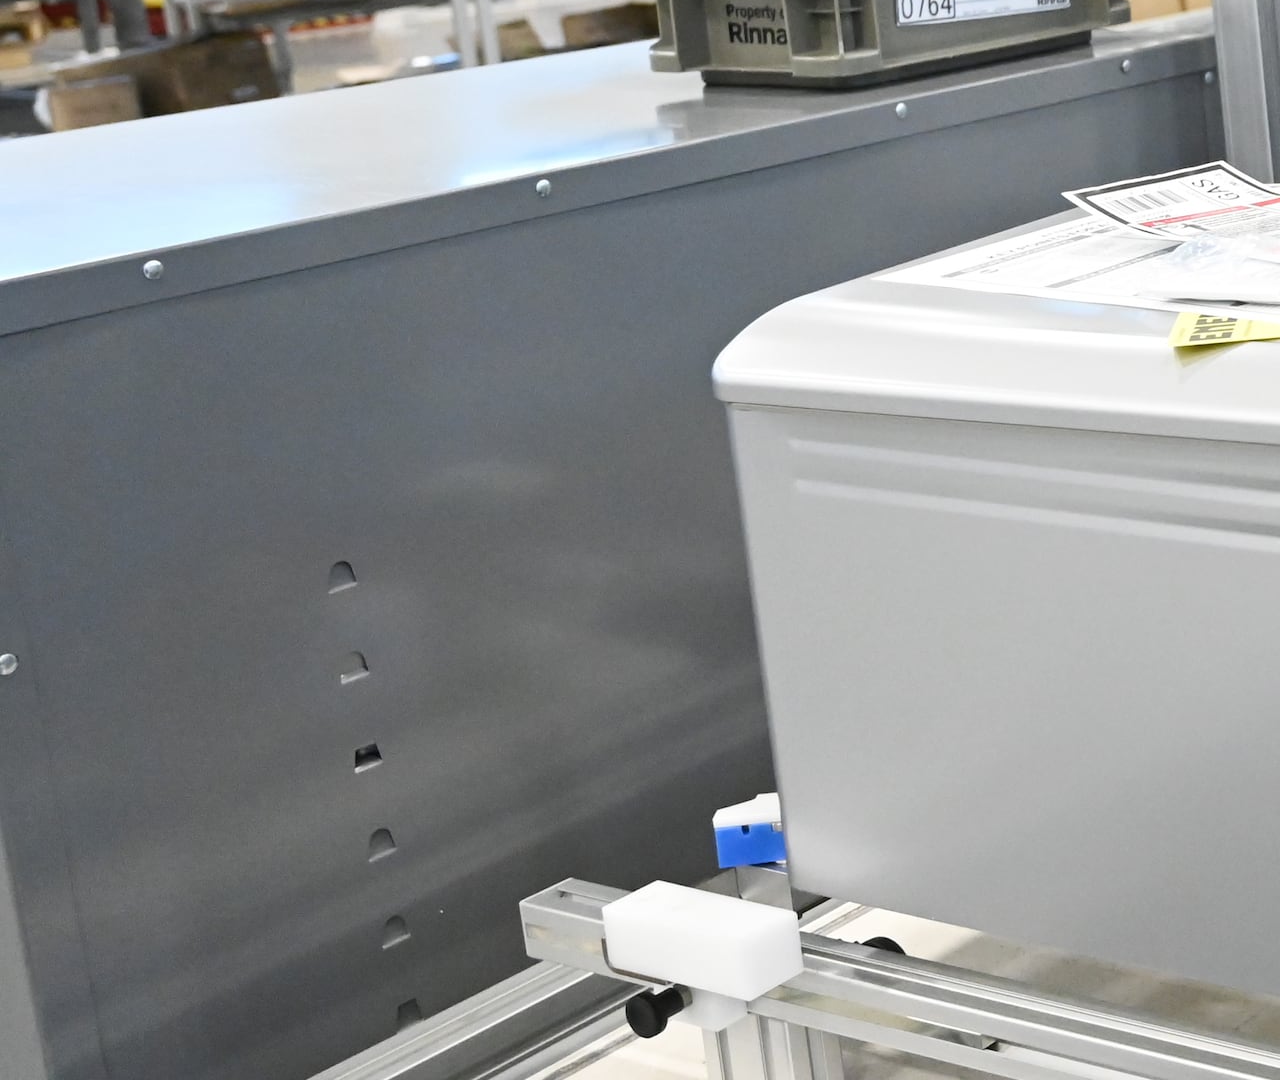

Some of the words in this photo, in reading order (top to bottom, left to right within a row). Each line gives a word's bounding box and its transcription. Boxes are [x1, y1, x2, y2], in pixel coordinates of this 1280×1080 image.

[725, 3, 776, 22] Property
[727, 21, 788, 45] Rinna
[1191, 178, 1241, 202] GAS
[1188, 314, 1238, 342] ENE
